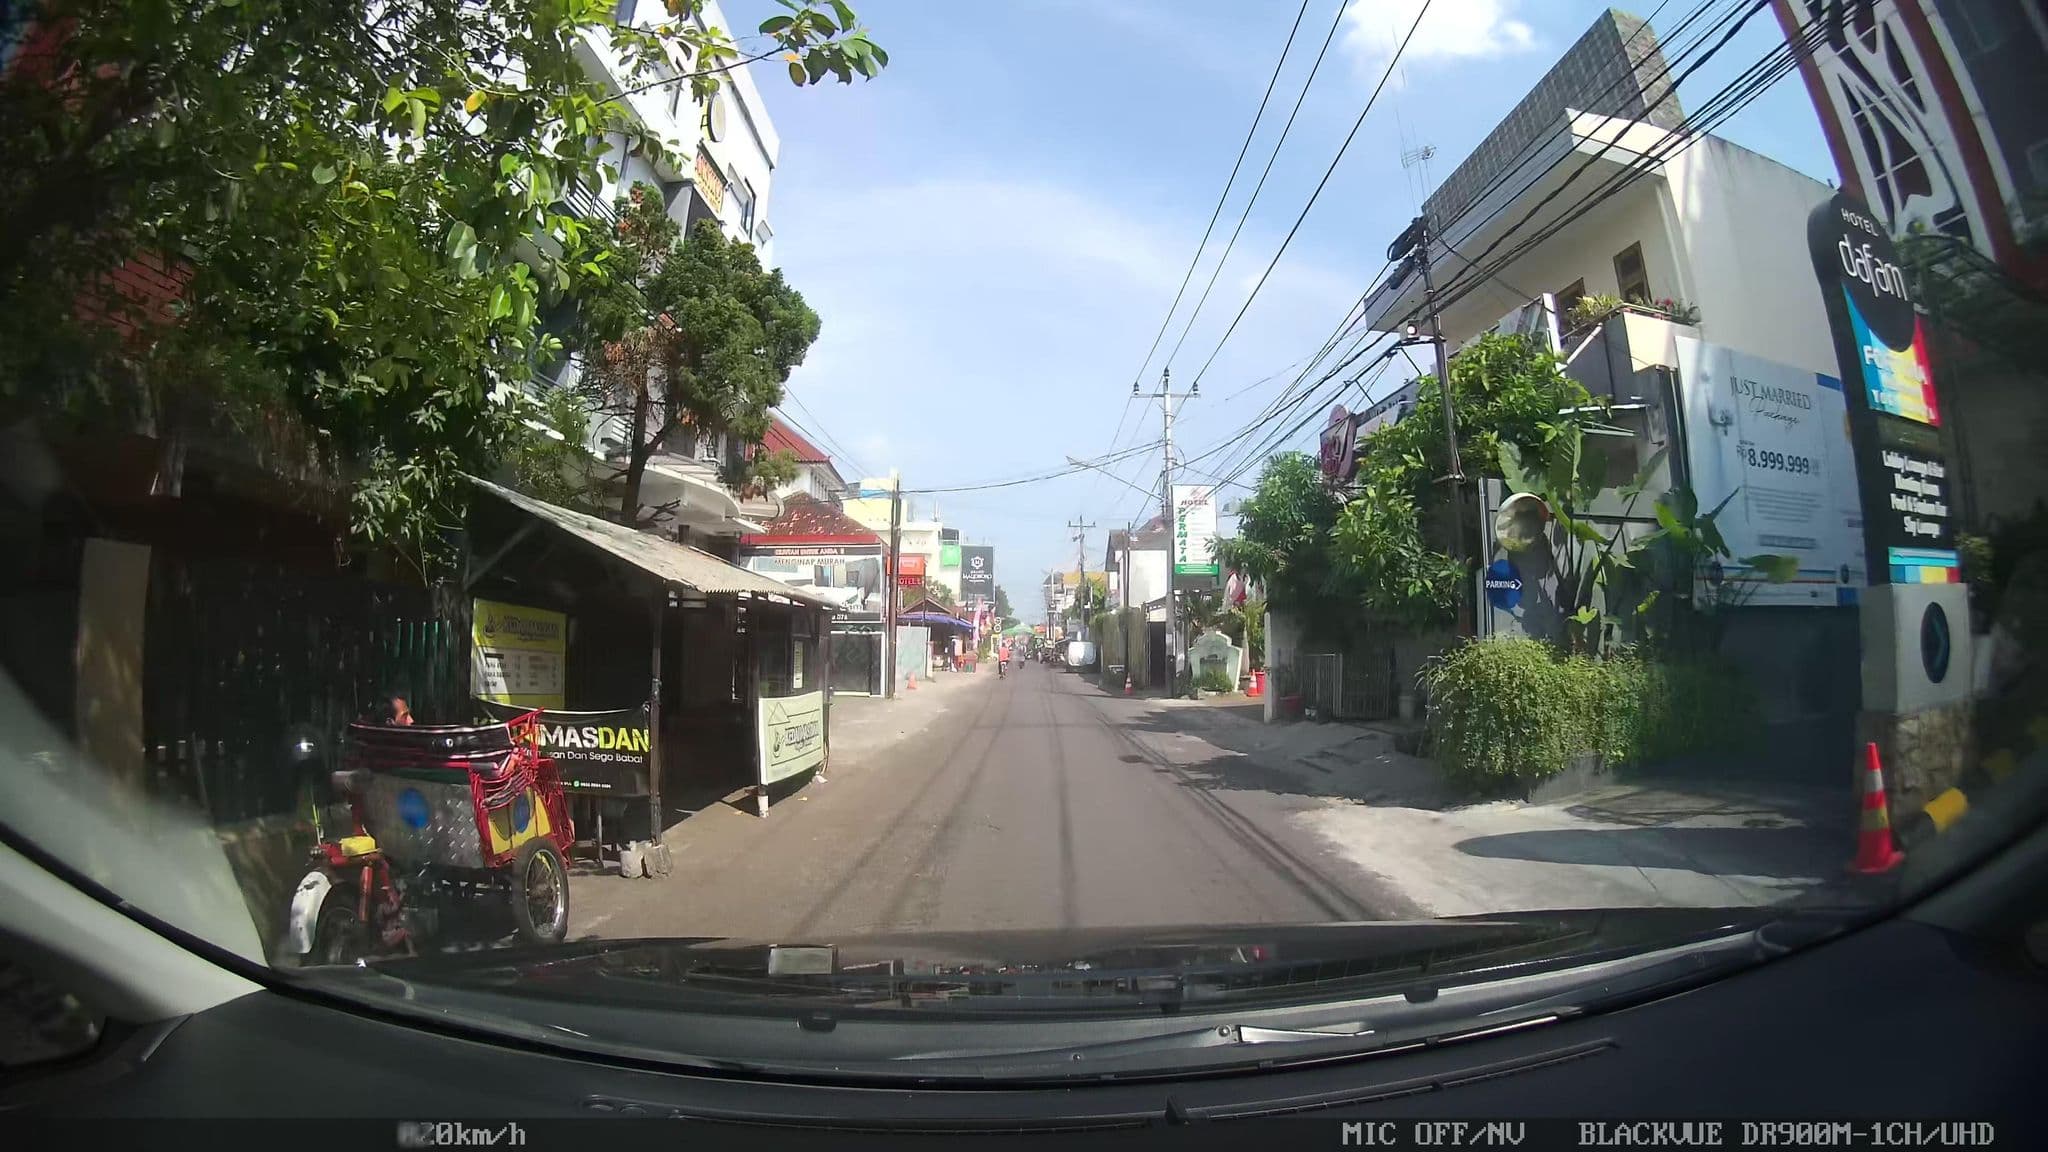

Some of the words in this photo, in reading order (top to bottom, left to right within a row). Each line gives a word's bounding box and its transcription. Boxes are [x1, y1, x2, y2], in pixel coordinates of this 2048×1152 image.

[1841, 208, 1879, 237] HOTEL
[1838, 233, 1908, 301] dafam
[1730, 376, 1758, 398] JUST
[1760, 385, 1811, 410] MARRIED
[1747, 448, 1809, 475] 8.999.999
[1177, 507, 1188, 563] PERMATA
[1485, 580, 1516, 589] PARKING
[567, 751, 588, 761] Dan
[589, 752, 614, 763] Sego
[615, 752, 643, 764] Babat
